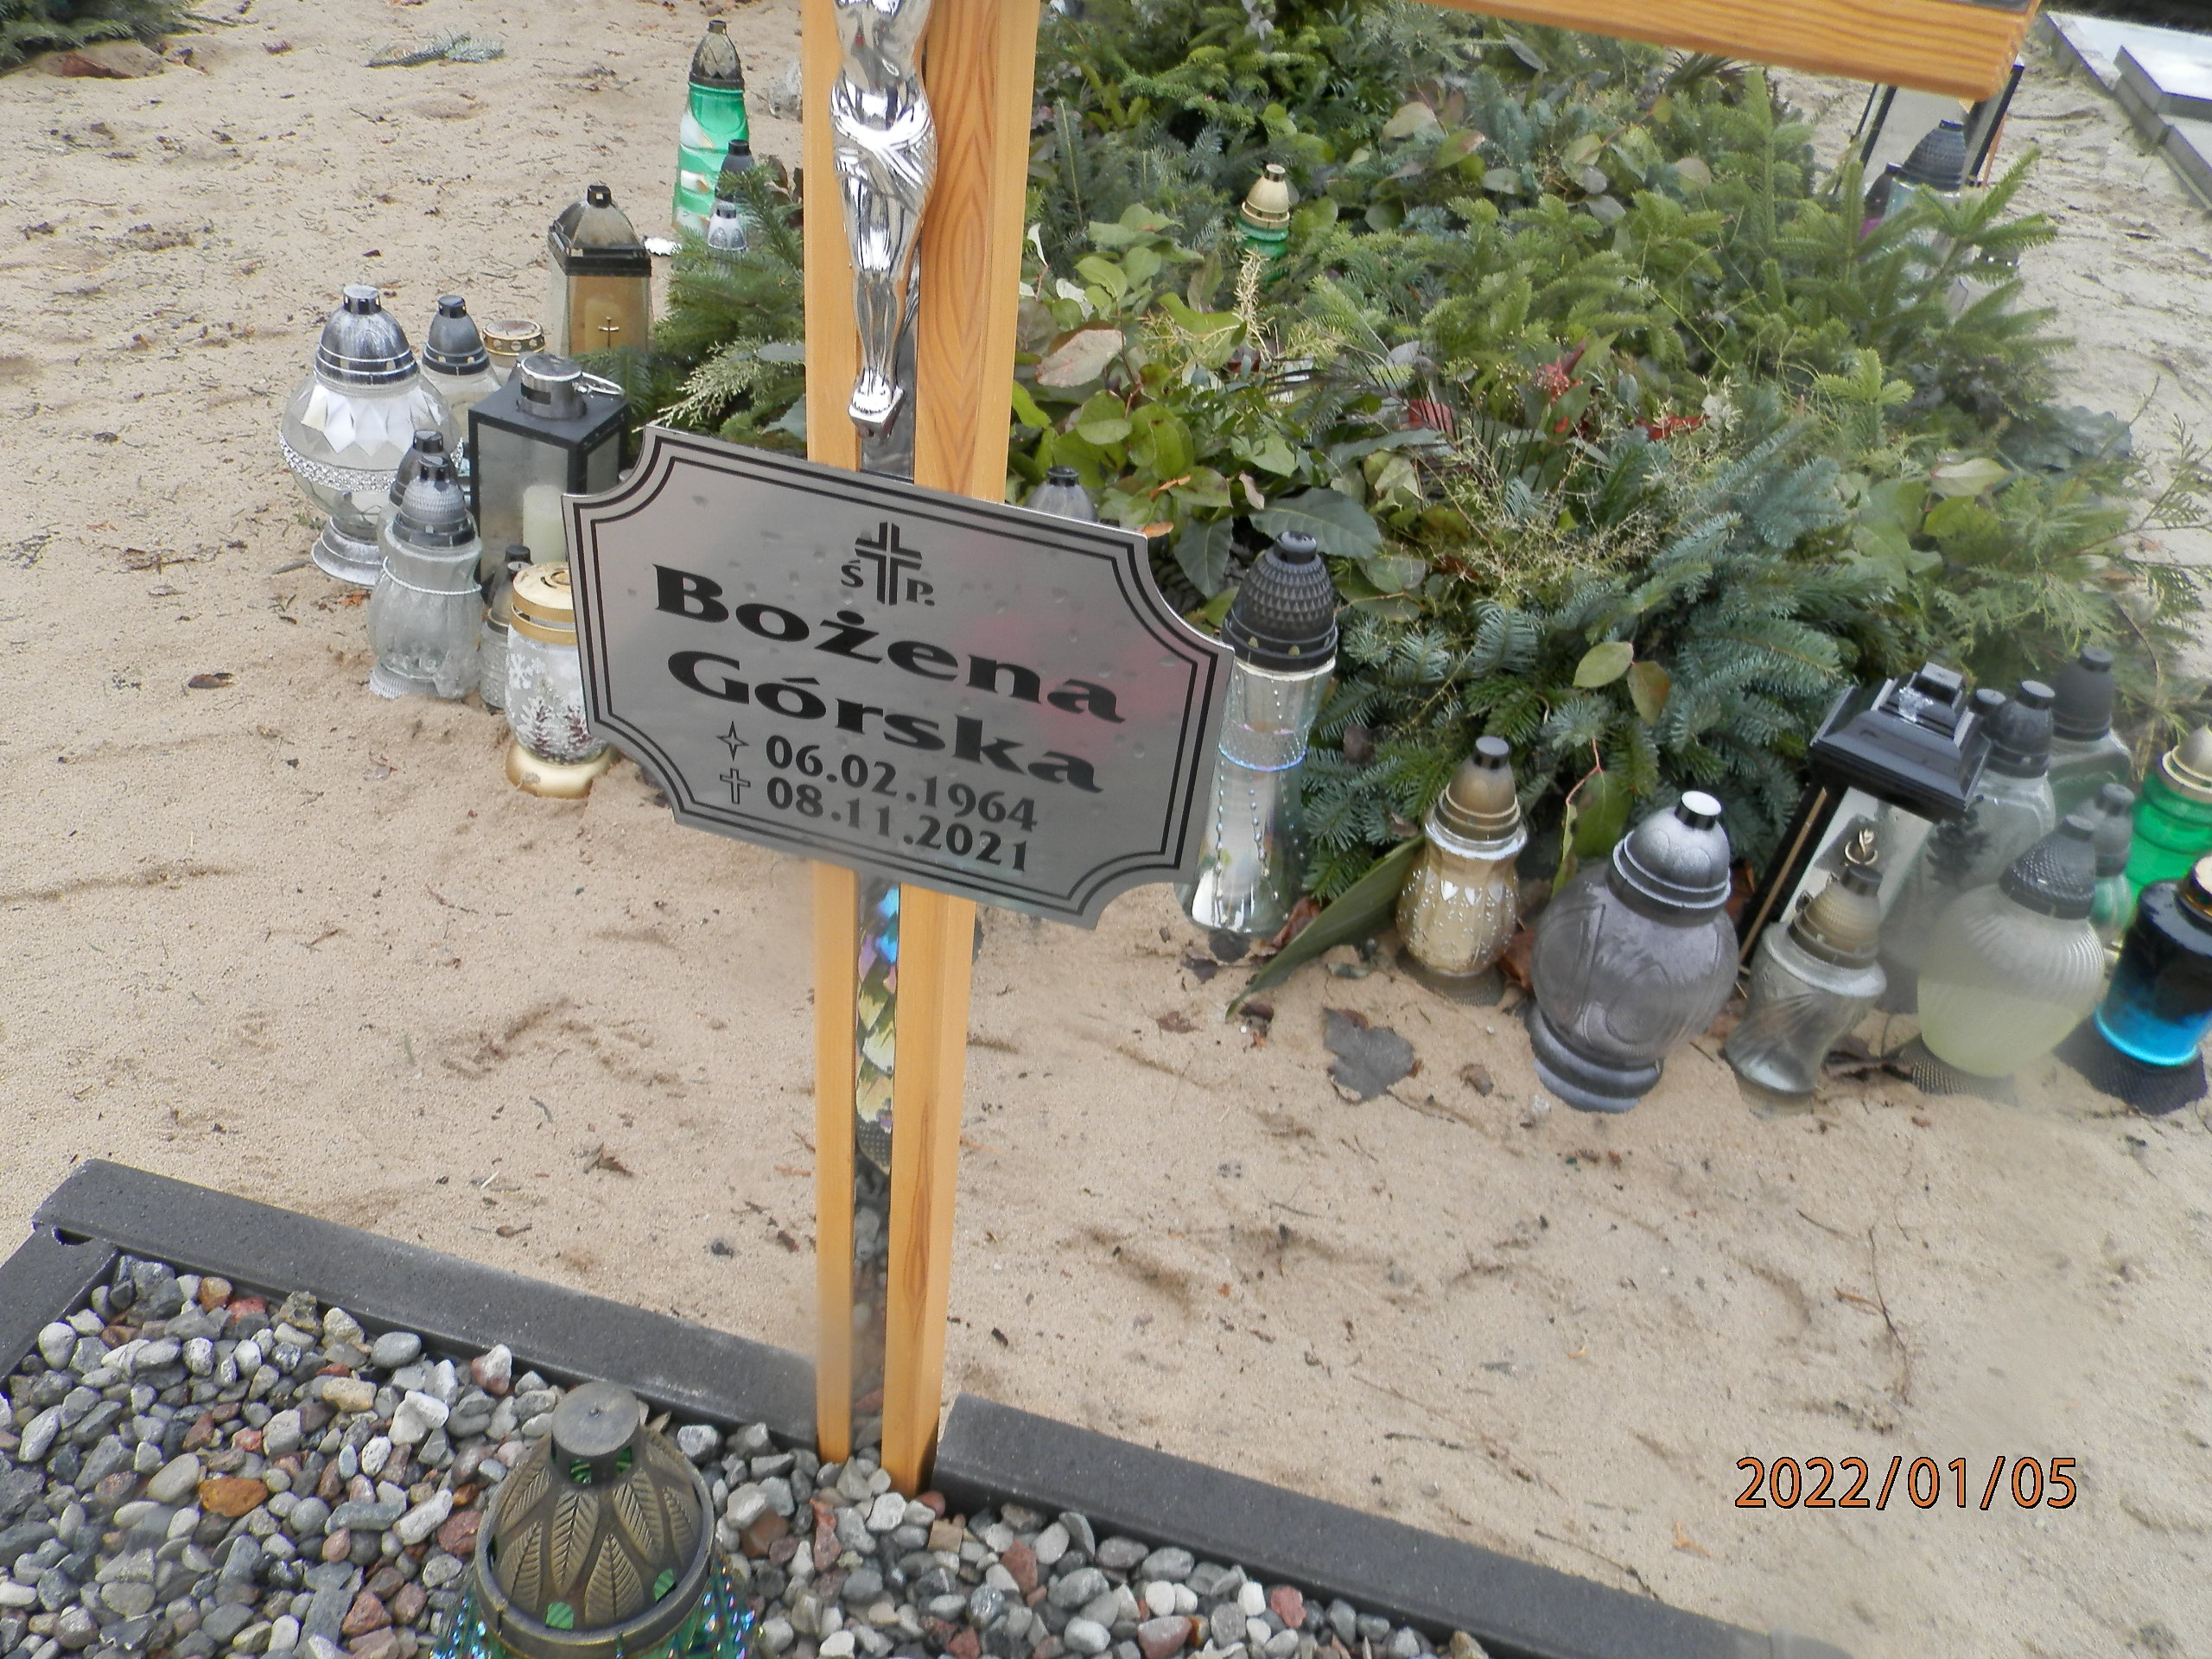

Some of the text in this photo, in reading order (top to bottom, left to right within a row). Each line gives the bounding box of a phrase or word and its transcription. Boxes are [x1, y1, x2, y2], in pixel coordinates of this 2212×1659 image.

[652, 564, 1125, 724] Bożena
[667, 650, 1104, 794] Górska
[766, 735, 1038, 833] 06.02.1964
[766, 777, 1028, 873] 08.11.2021
